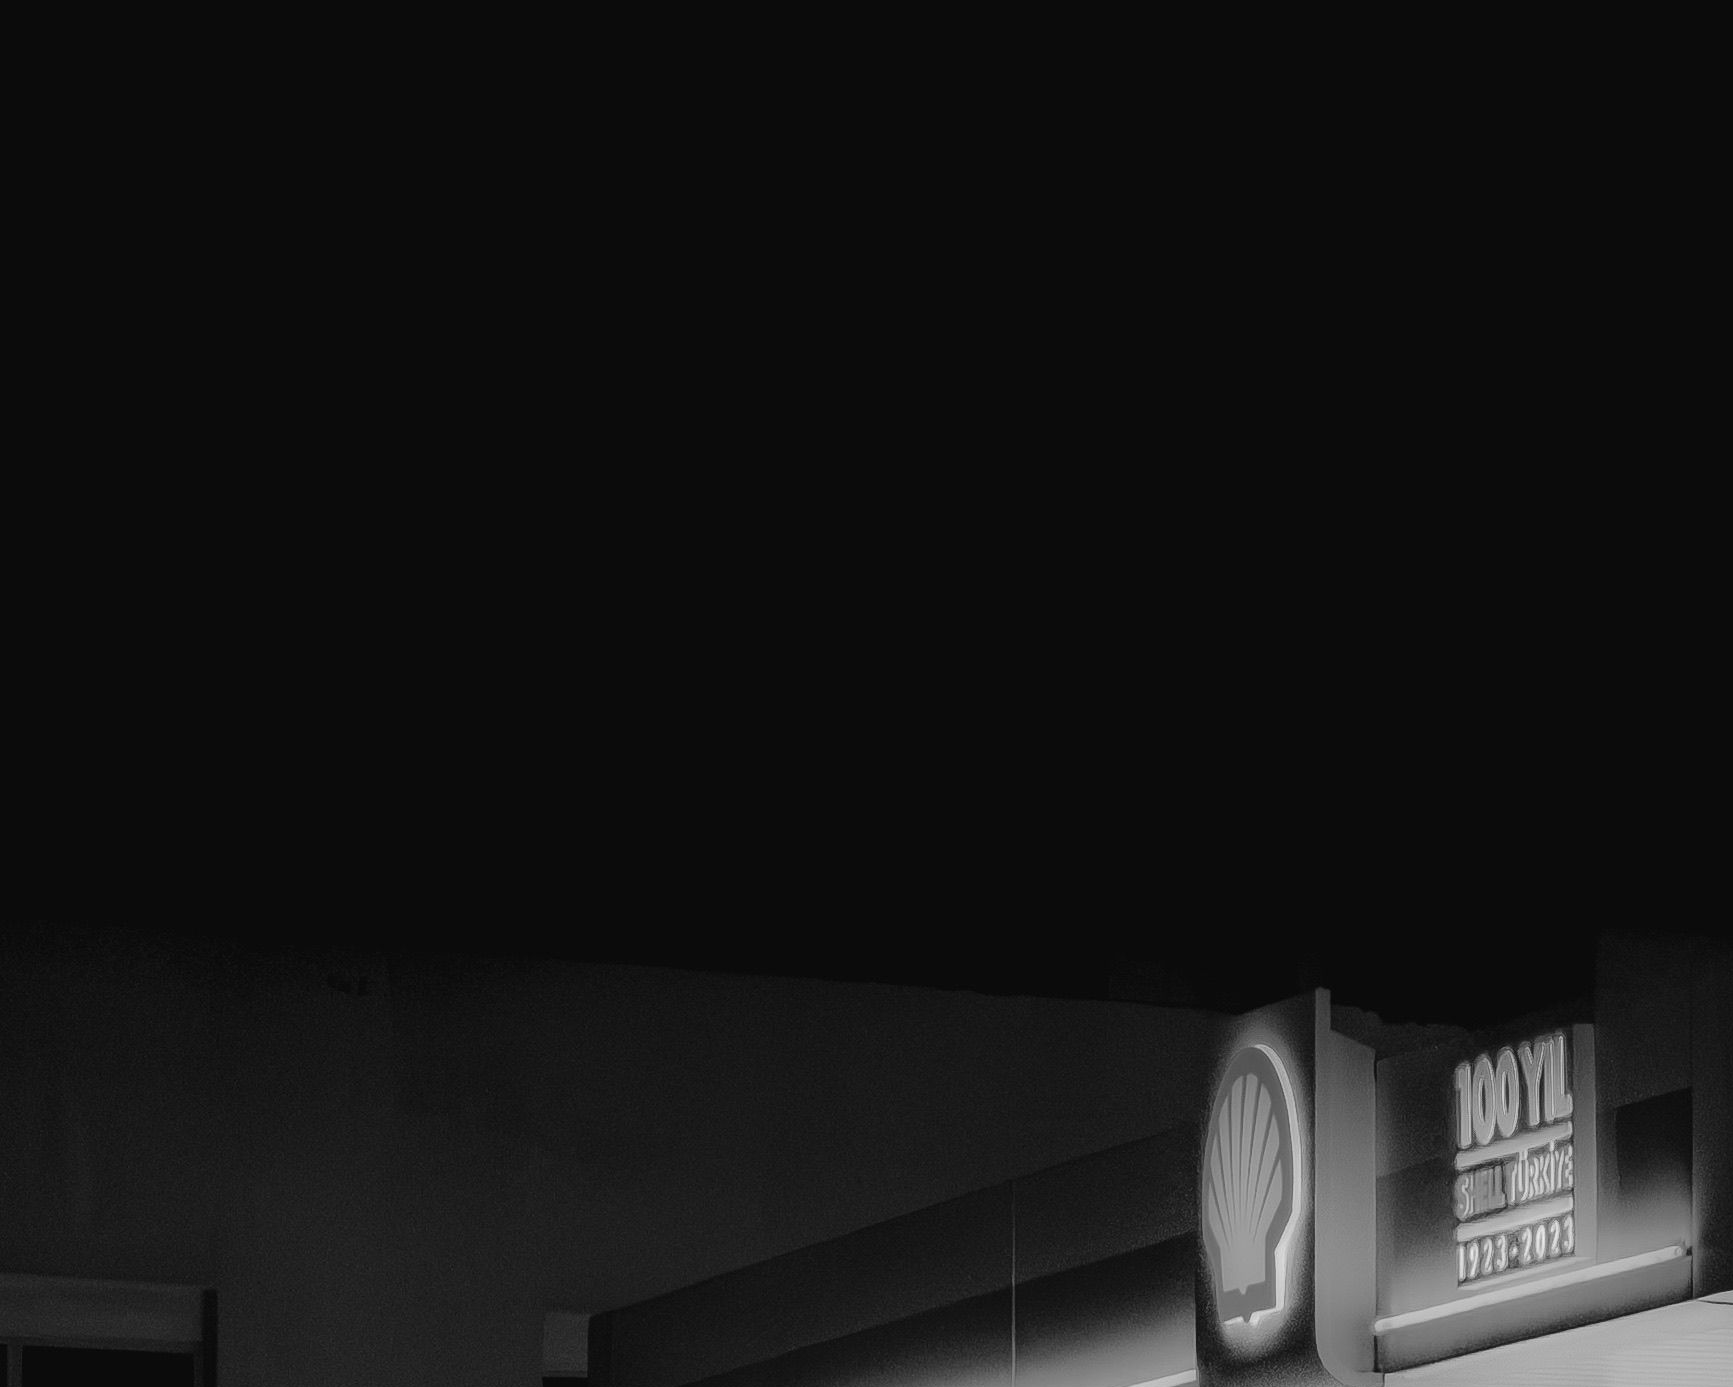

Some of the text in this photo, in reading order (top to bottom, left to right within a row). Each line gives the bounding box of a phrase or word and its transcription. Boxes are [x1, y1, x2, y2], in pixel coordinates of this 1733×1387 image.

[1454, 1031, 1573, 1150] 100 YIL
[1455, 1163, 1508, 1222] SHELL
